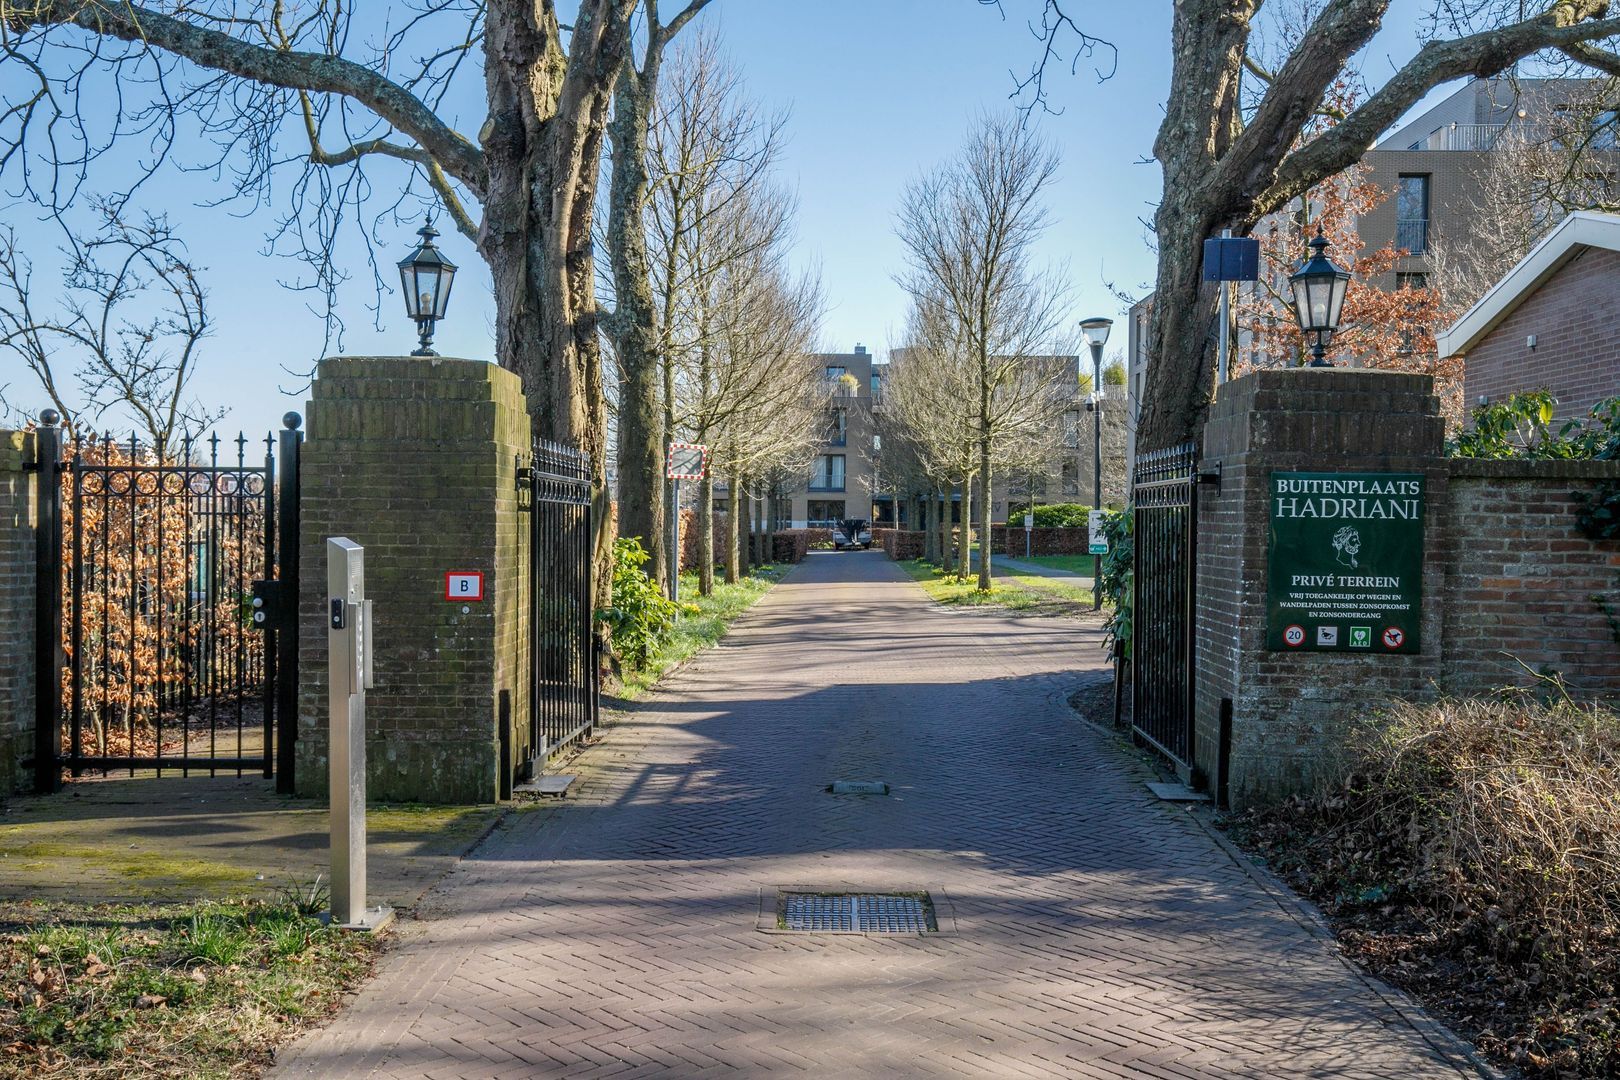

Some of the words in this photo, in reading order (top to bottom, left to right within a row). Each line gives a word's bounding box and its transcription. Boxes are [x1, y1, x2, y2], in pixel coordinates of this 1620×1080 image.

[1276, 479, 1420, 495] BUITENPLAATS
[1276, 498, 1419, 519] HADRIANI
[461, 580, 469, 592] B
[1292, 573, 1334, 587] PRIVÉ
[1337, 576, 1400, 588] TERREIN
[1279, 601, 1331, 609] WANDELPADEN
[1288, 631, 1301, 640] 20
